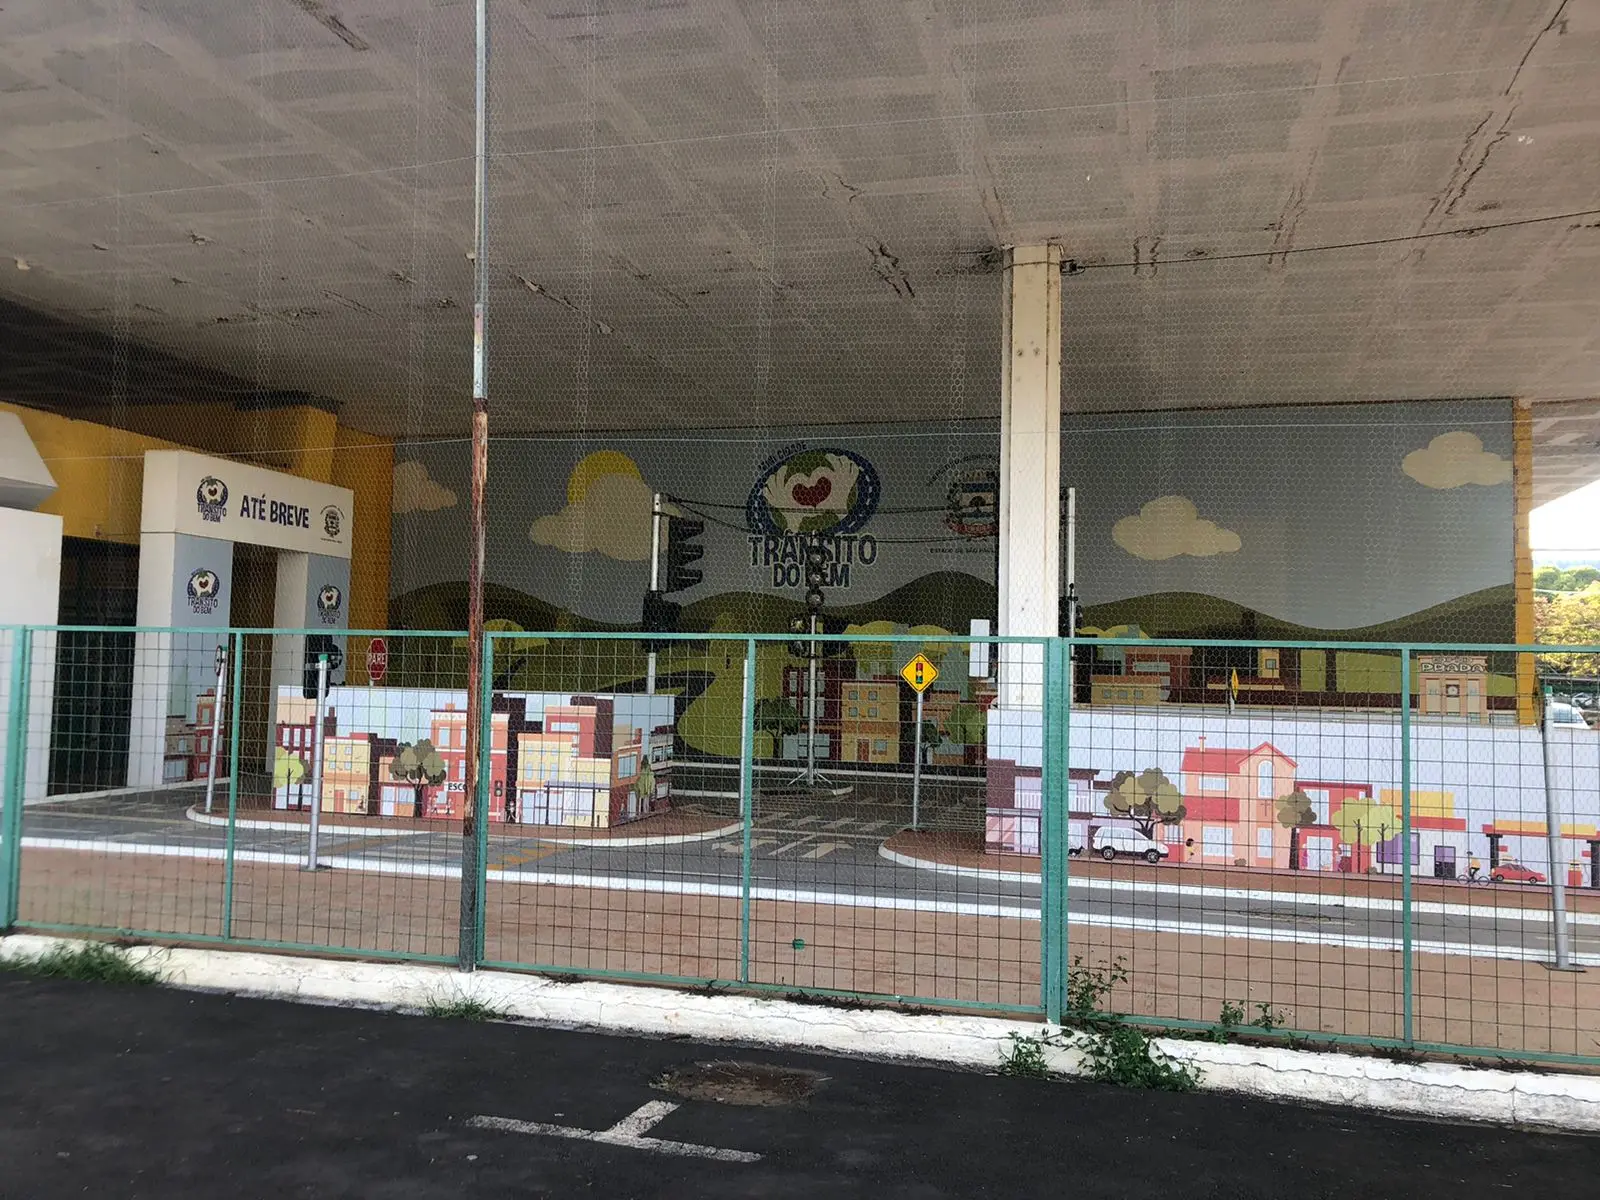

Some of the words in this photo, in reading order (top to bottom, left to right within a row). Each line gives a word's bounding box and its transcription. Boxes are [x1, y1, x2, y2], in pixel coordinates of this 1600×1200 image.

[240, 493, 266, 521] ATÉ
[269, 500, 310, 529] BREVE
[773, 562, 800, 588] DO
[366, 652, 386, 665] PARE
